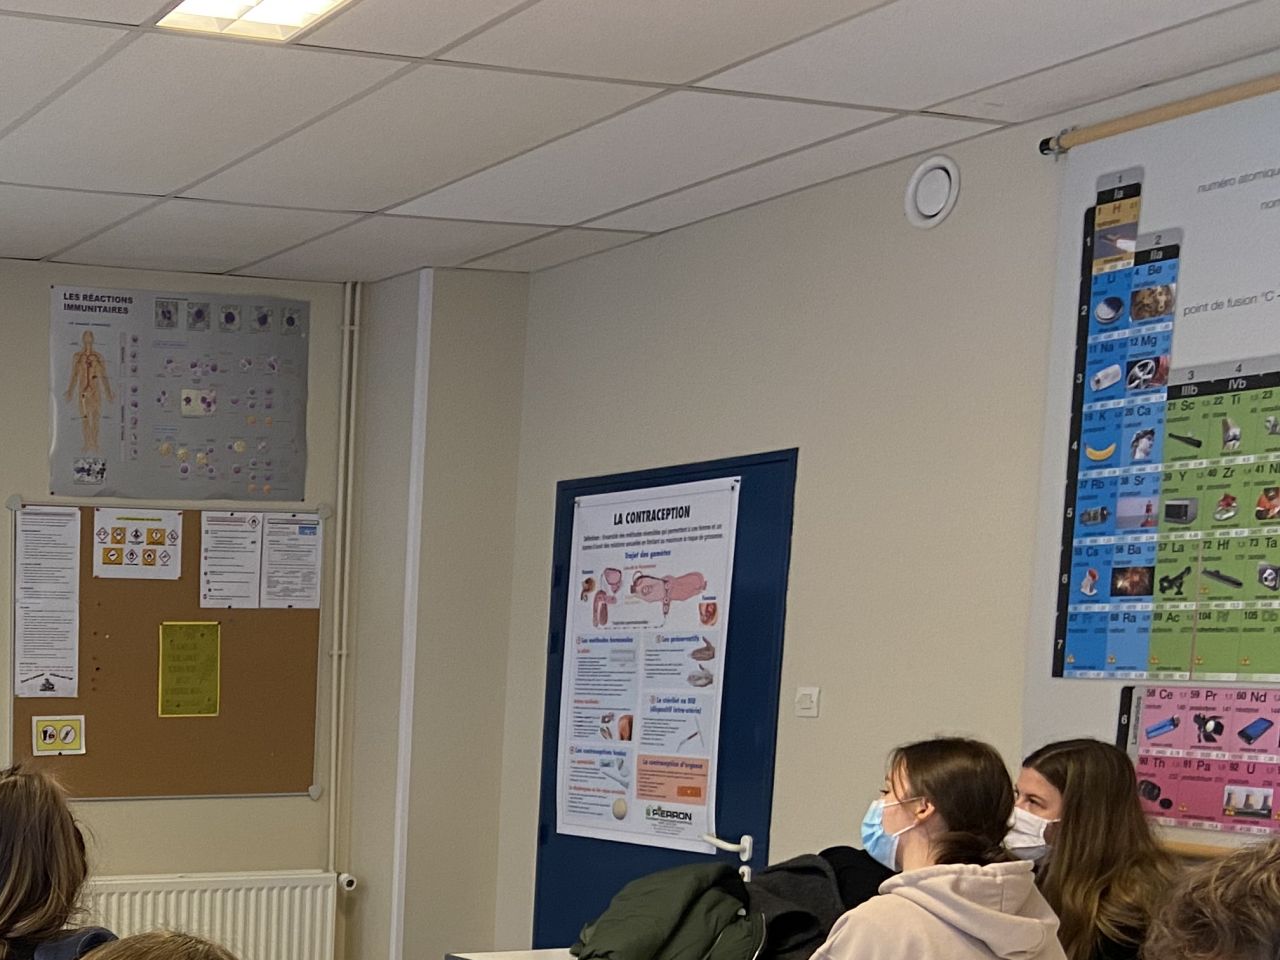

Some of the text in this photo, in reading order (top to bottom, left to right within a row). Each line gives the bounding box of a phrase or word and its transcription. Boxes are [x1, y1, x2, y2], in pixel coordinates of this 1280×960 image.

[1113, 203, 1121, 214] H
[1086, 236, 1091, 247] 1
[1154, 234, 1162, 245] 2
[1147, 264, 1162, 276] Be
[64, 293, 80, 301] LES
[64, 303, 128, 314] IMMUNITAIRES
[1080, 305, 1088, 316] 2
[1183, 302, 1209, 317] point
[1211, 301, 1224, 311] de
[1227, 295, 1258, 308] fusion
[1130, 335, 1157, 348] 12 Mg
[1100, 343, 1114, 353] Na
[1235, 363, 1242, 373] 4
[1075, 373, 1083, 384] 3
[1188, 370, 1195, 380] 3
[1228, 379, 1247, 390] IVb
[1181, 385, 1198, 396] IIIb
[1262, 390, 1273, 399] 23
[1214, 394, 1241, 405] 22 Ti
[1167, 400, 1196, 411] 21 Sc
[1099, 411, 1107, 421] K
[1137, 406, 1151, 417] Ca
[1072, 441, 1079, 450] 4
[1223, 467, 1235, 478] Zr
[1255, 465, 1264, 473] 41
[1134, 475, 1145, 486] Sr
[1179, 471, 1187, 481] Y
[1091, 480, 1105, 489] Rb
[614, 505, 691, 526] LA CONTRACEPTION
[1066, 507, 1073, 518] 5
[1172, 542, 1185, 552] La
[1203, 539, 1230, 550] 72 Hf
[1249, 537, 1278, 548] 73 Ta
[1086, 547, 1099, 557] Cs
[1127, 544, 1142, 555] Ba
[1062, 574, 1068, 584] 6
[1123, 613, 1137, 623] Ra
[1166, 612, 1180, 622] Ac
[1198, 612, 1212, 620] 104
[1244, 611, 1258, 619] 105
[1056, 639, 1064, 650] 7
[1147, 689, 1173, 700] 58 Ce
[1190, 690, 1218, 701] 59 Pr
[1236, 691, 1267, 703] 60 Nd
[1121, 714, 1128, 725] 6
[1152, 757, 1166, 769] Th
[1196, 761, 1211, 771] Pa
[1230, 762, 1256, 774] 92 U
